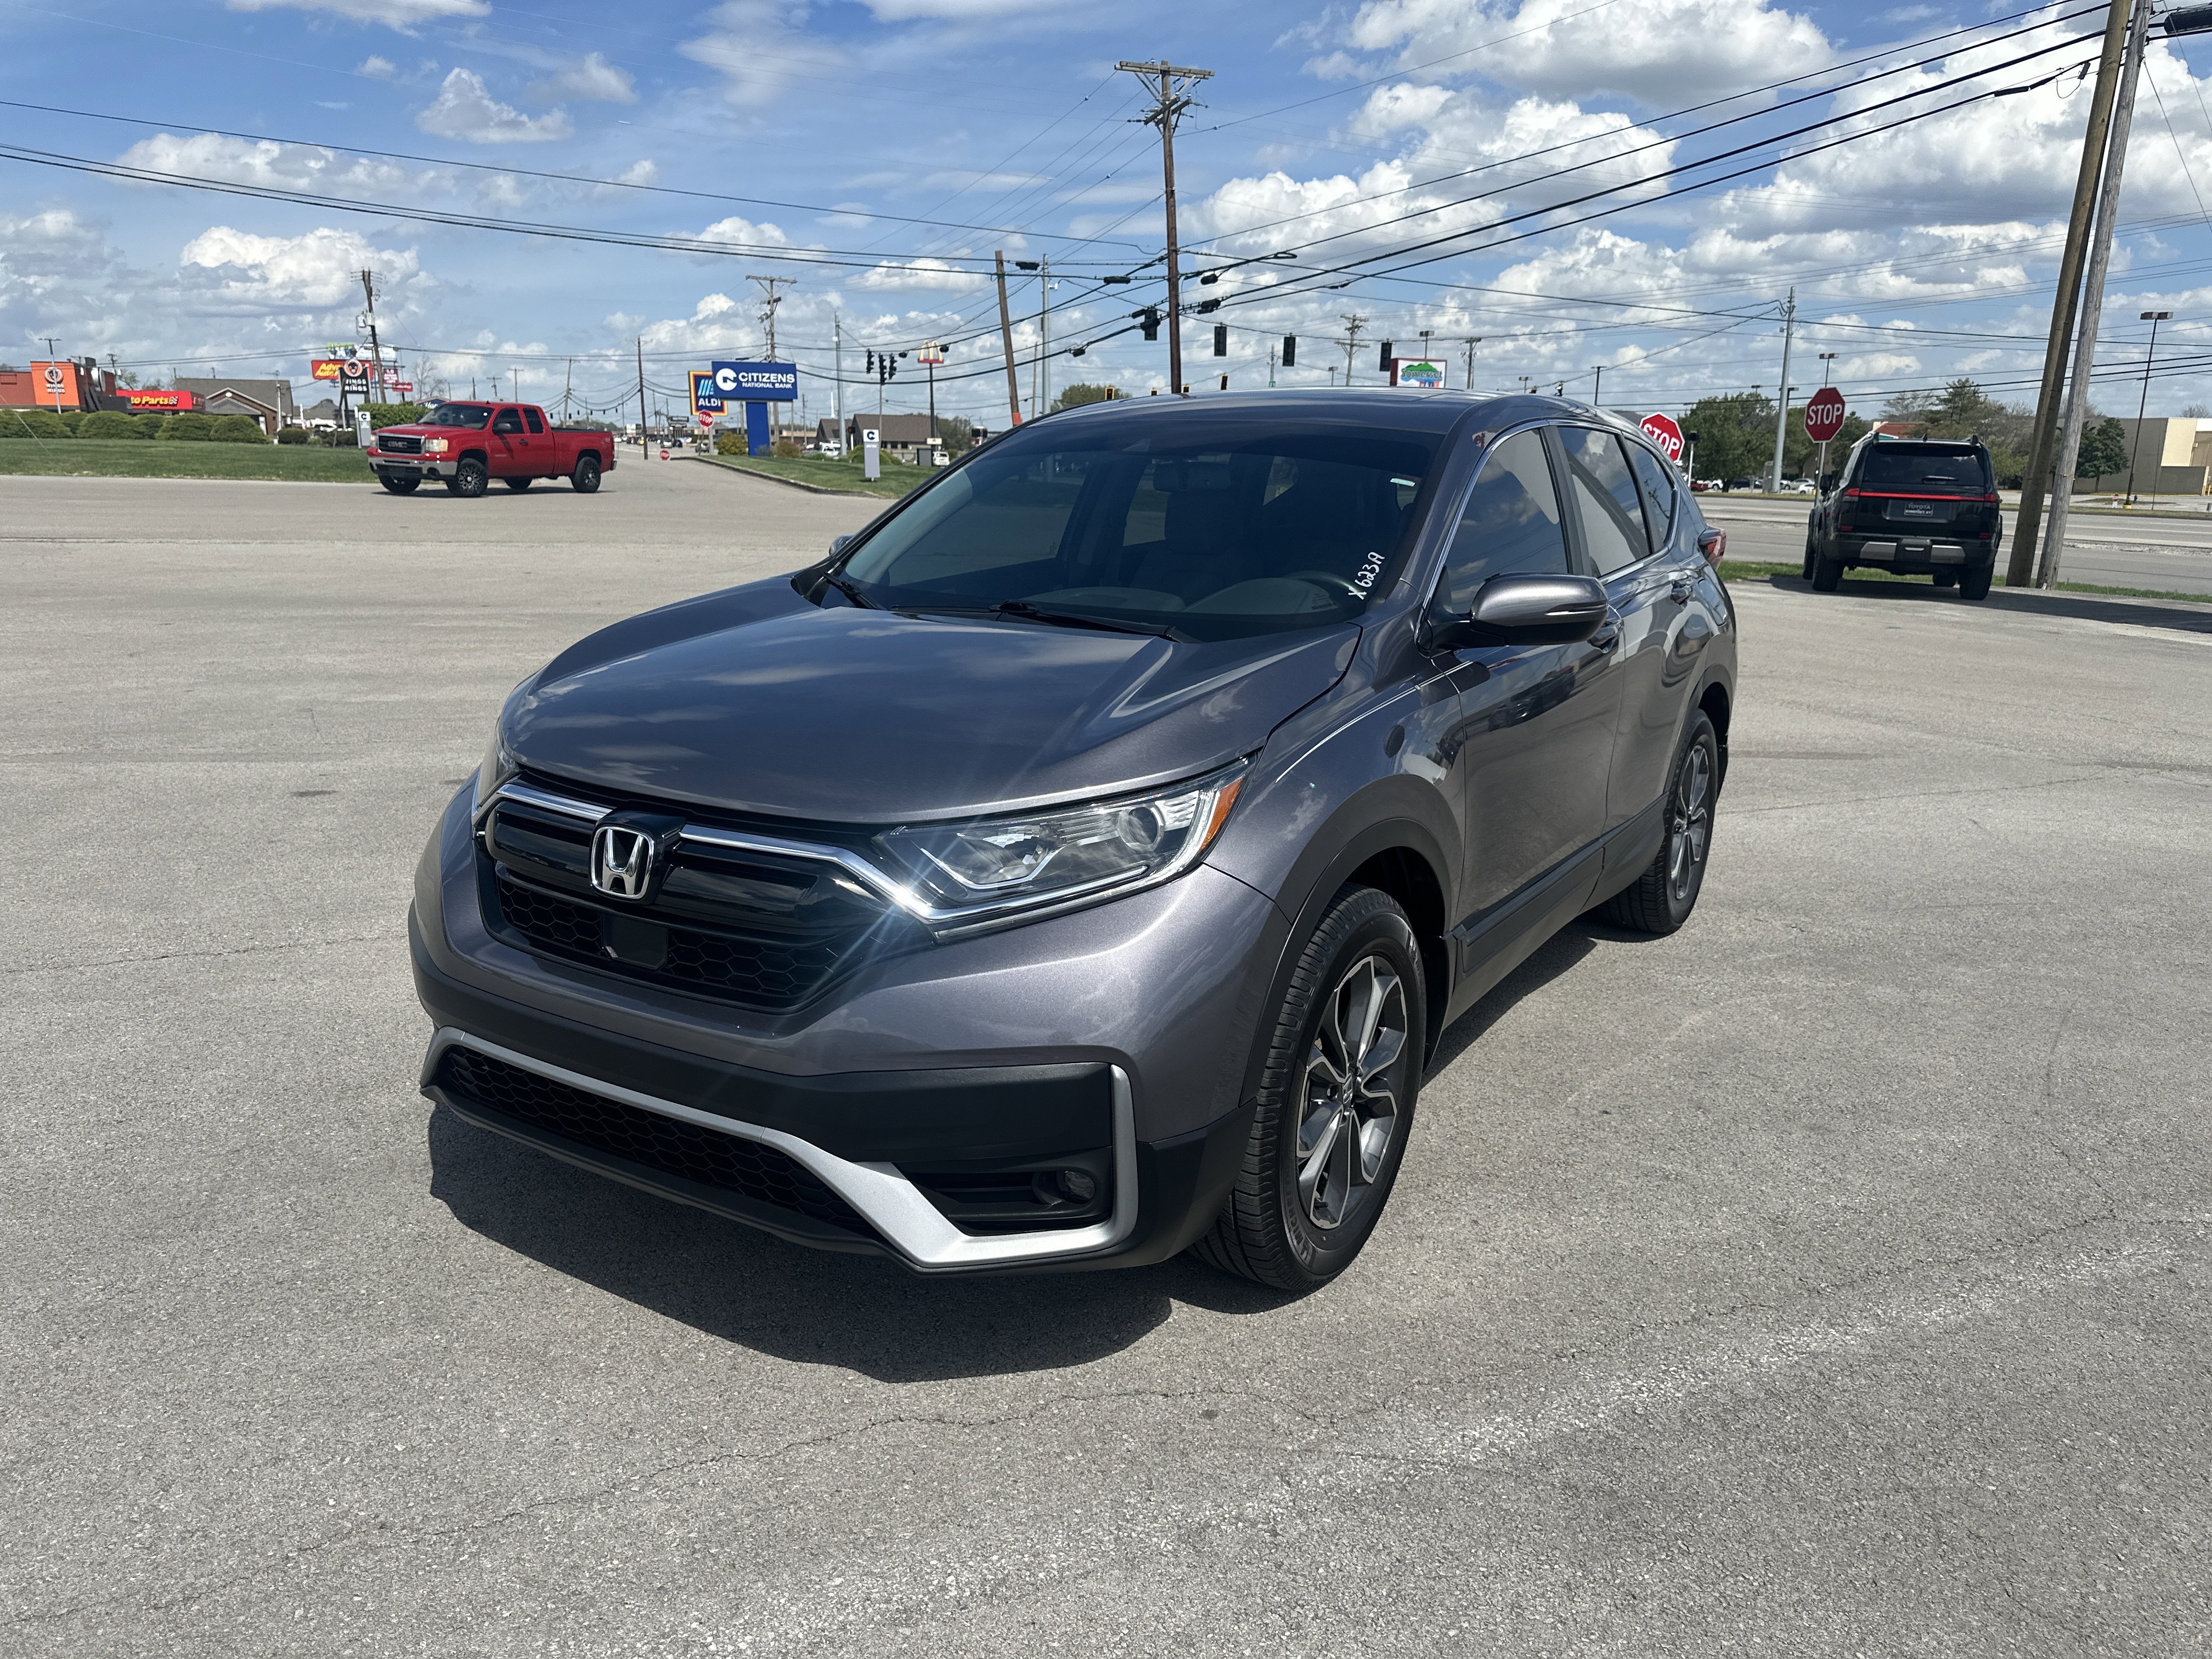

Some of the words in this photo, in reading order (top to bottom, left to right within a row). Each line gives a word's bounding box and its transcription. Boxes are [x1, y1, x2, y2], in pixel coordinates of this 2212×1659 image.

[738, 372, 795, 383] CITIZENS
[131, 396, 141, 405] to
[142, 396, 169, 405] Parts
[698, 397, 721, 407] ALDI
[699, 413, 713, 424] STOP
[1808, 404, 1842, 425] STOP
[1348, 552, 1385, 600] X623A
